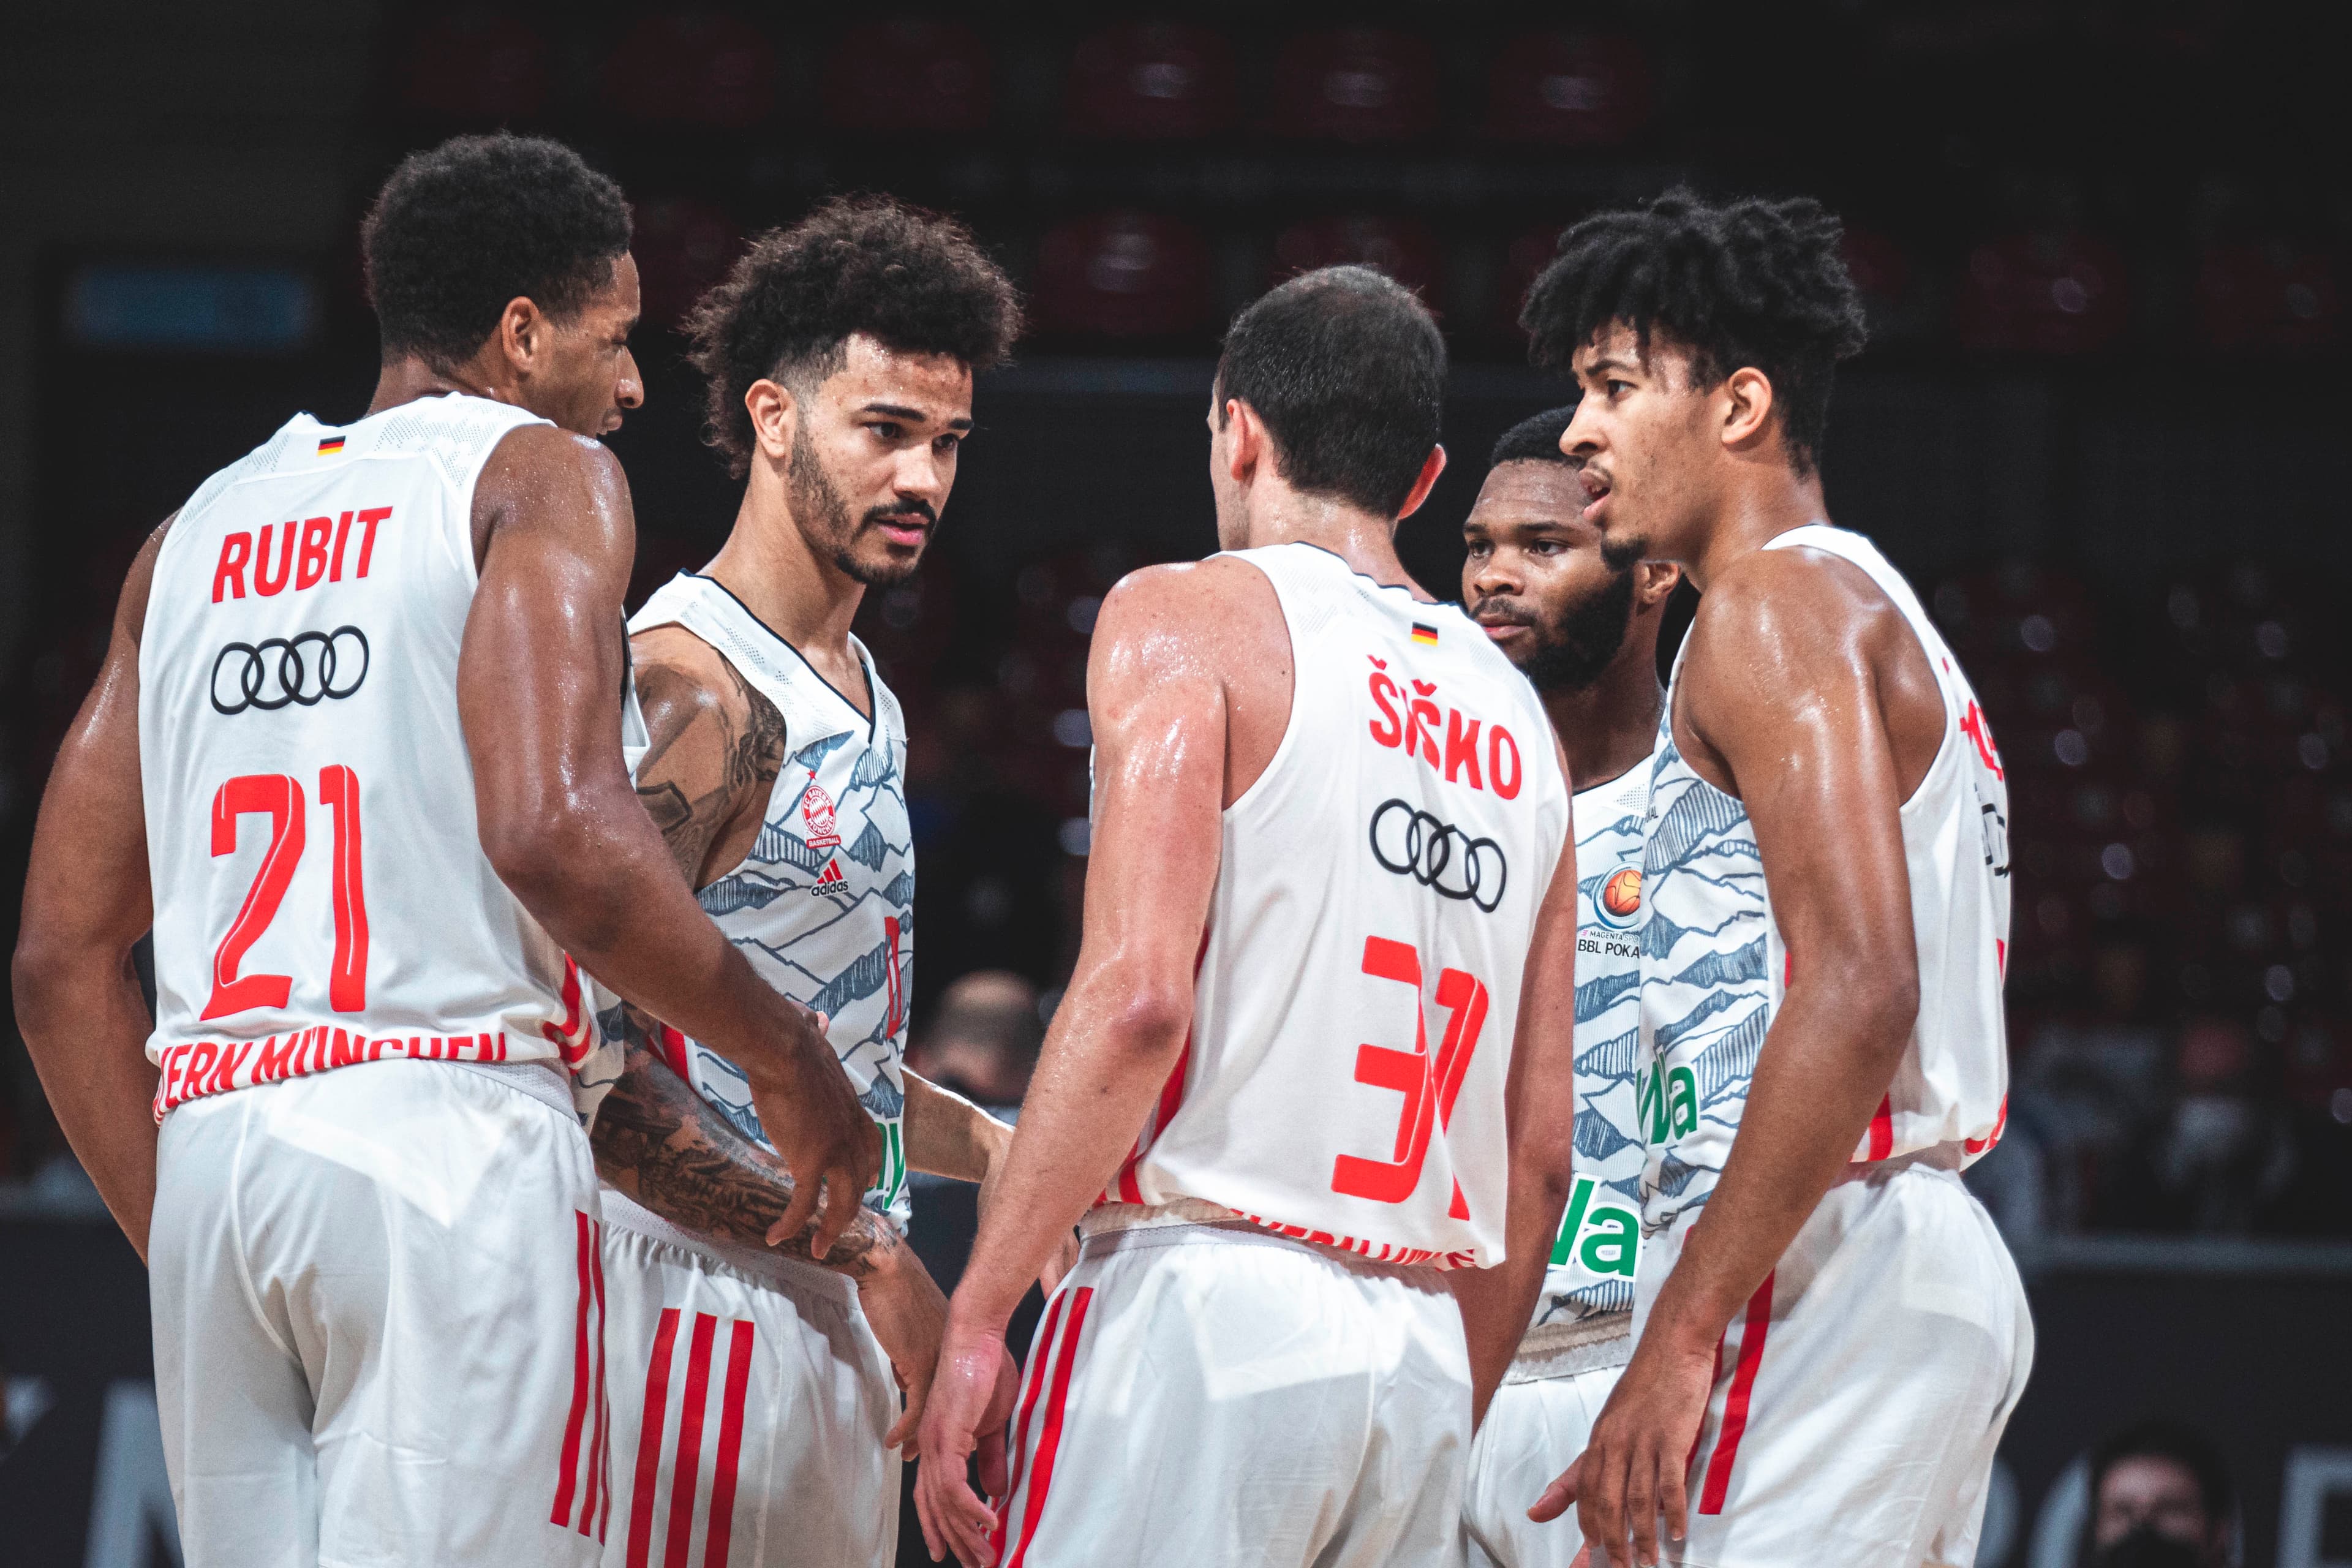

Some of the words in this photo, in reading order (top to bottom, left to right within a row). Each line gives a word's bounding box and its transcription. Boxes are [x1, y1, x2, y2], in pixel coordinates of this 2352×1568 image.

[211, 505, 393, 603] RUBIT
[1366, 654, 1522, 800] ŠIŠKO
[808, 789, 831, 808] BAYERN
[807, 815, 834, 835] MÜNCHEN
[809, 837, 840, 846] BASKETBALL
[200, 764, 369, 1021] 21
[811, 881, 849, 896] adidas
[1577, 938, 1601, 954] BBL
[1330, 935, 1489, 1221] 31
